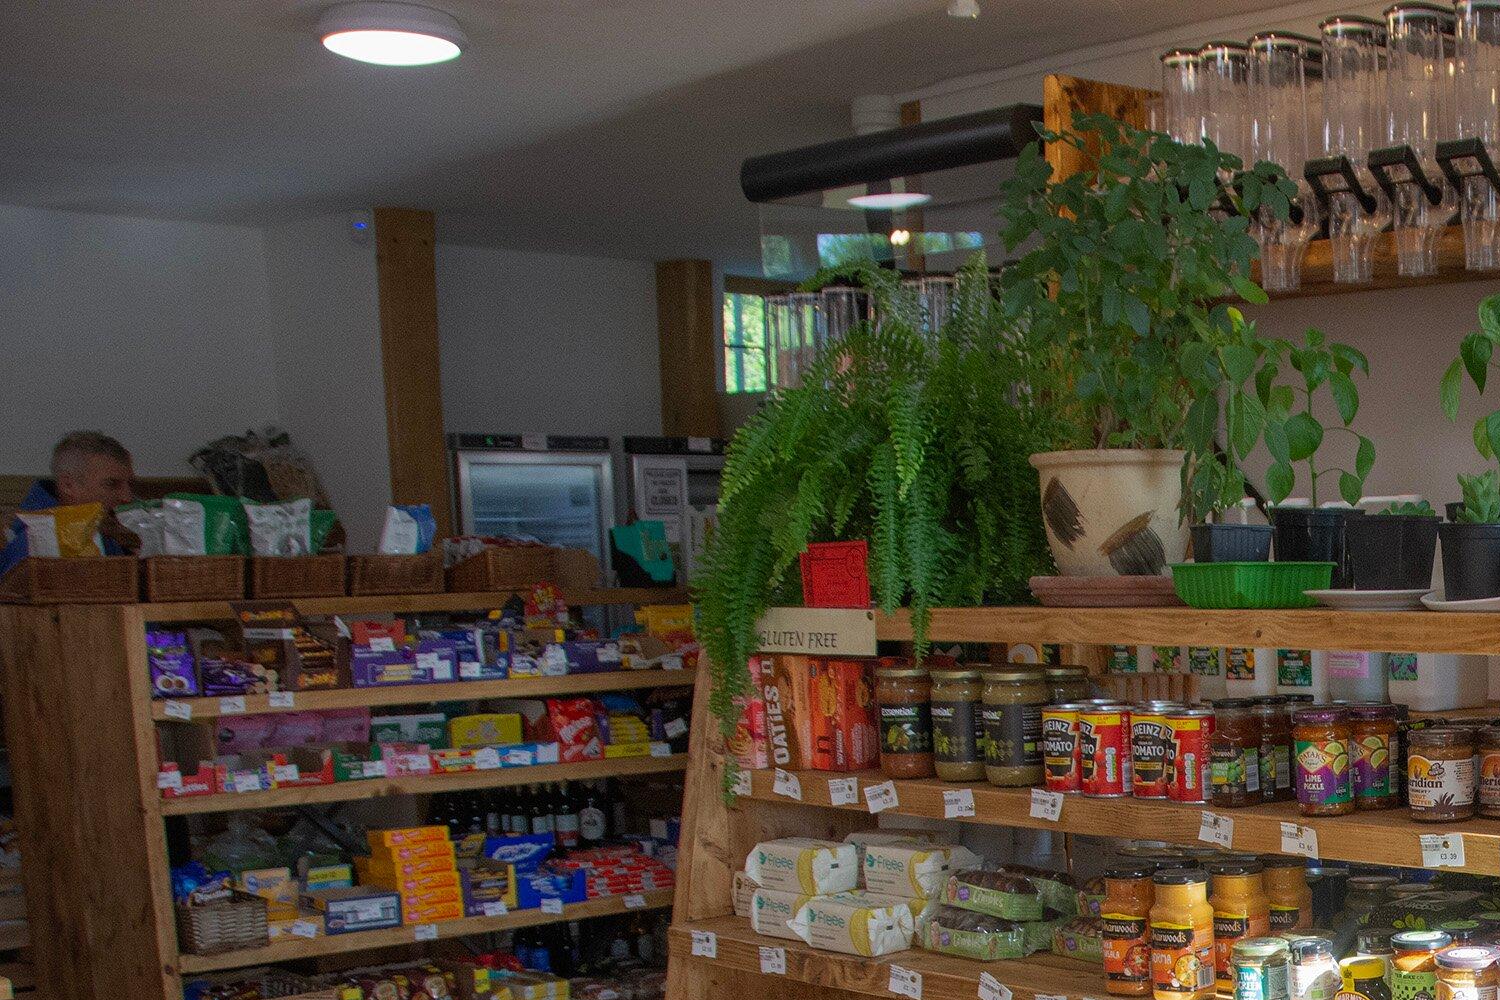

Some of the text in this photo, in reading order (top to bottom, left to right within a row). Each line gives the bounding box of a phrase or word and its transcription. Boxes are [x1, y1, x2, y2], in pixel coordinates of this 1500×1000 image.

[760, 630, 839, 649] GLUTEN FREE
[764, 684, 791, 766] OATIES
[1043, 720, 1070, 733] HEINZ
[1133, 723, 1160, 737] HEINZ
[1043, 741, 1073, 752] TOMATO
[1132, 744, 1165, 756] TOMATO
[1304, 774, 1322, 783] LIME
[1303, 782, 1325, 791] PICKLE
[767, 853, 794, 870] freee
[877, 853, 905, 873] freee
[765, 896, 791, 914] freee
[818, 909, 845, 929] freee
[1238, 972, 1256, 982] THAI
